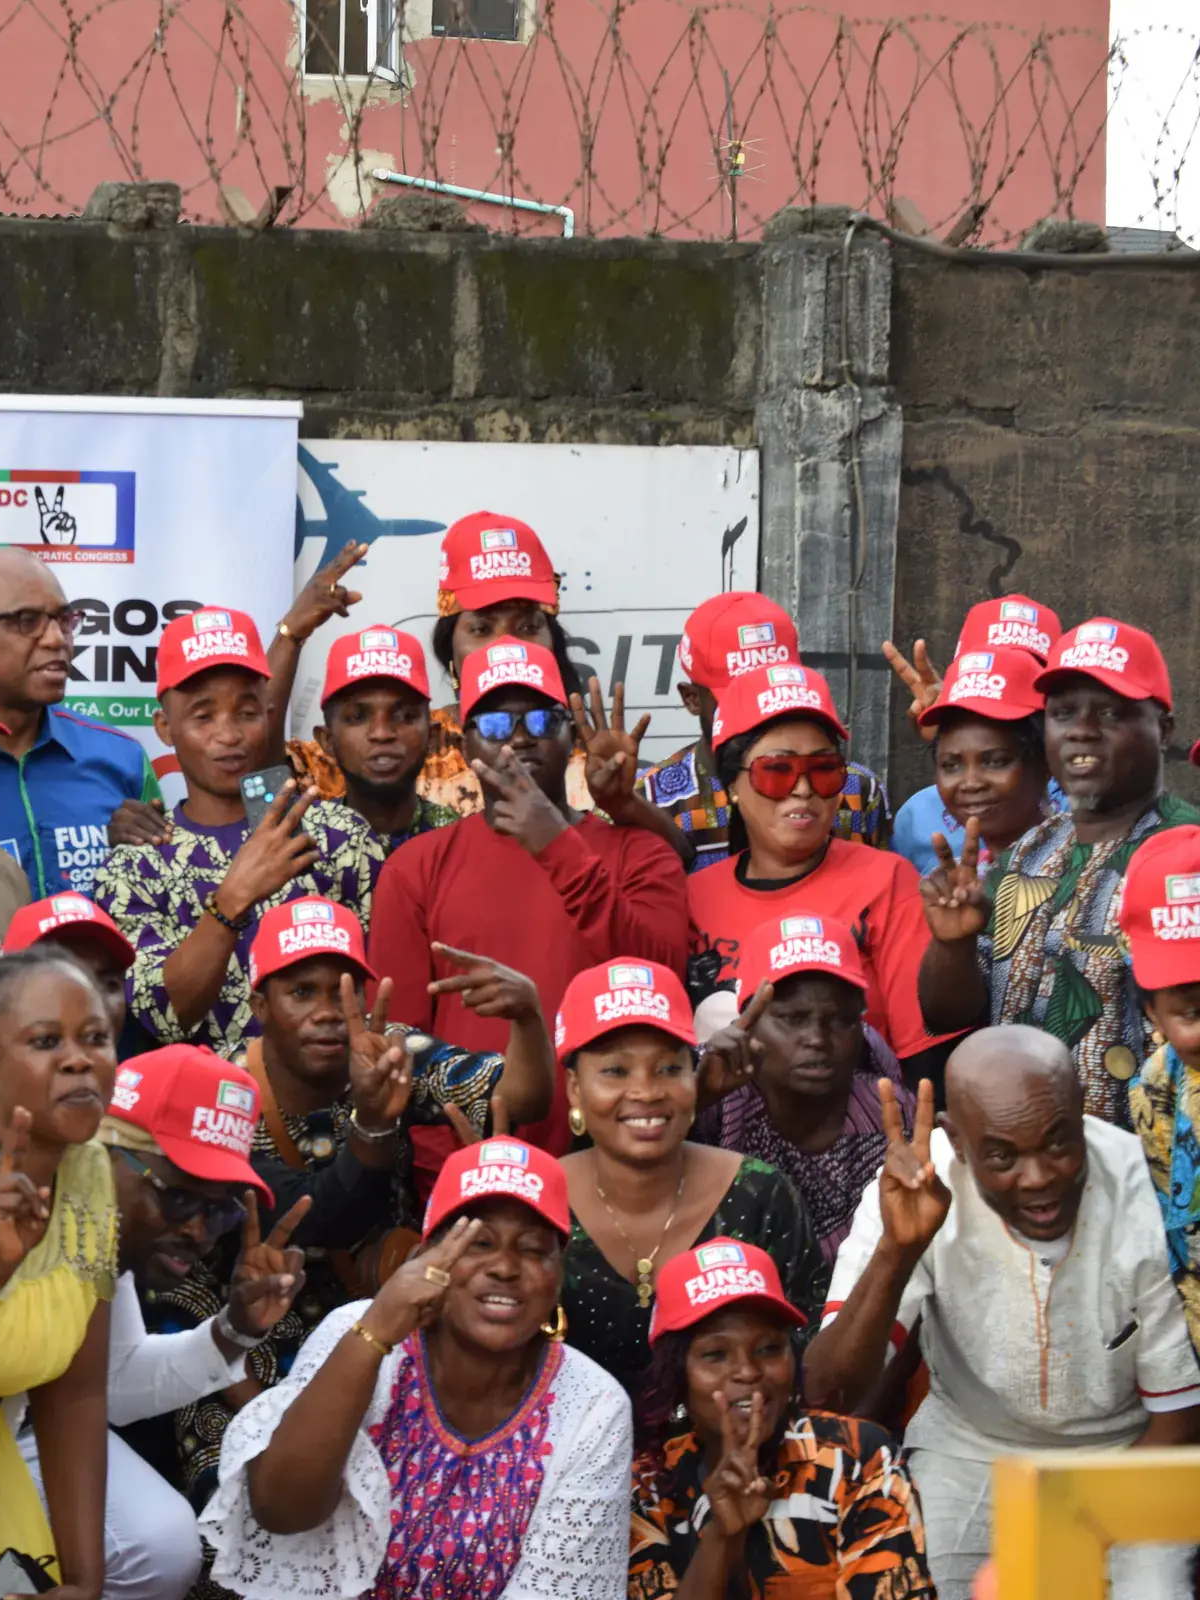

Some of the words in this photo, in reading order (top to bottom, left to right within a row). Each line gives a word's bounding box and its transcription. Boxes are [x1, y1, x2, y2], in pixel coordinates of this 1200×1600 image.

[75, 551, 128, 562] CONGRESS
[470, 551, 531, 574] FUNSO
[182, 631, 248, 655] FUNSO
[988, 622, 1051, 647] FUNSO
[347, 651, 412, 671] FUNSO
[726, 645, 789, 669] FUNSO
[477, 661, 543, 688] FUNSO
[757, 685, 820, 709] FUNSO
[108, 703, 140, 717] Our
[279, 924, 351, 948] FUNSO
[770, 938, 840, 962] FUNSO
[594, 988, 670, 1014] FUNSO
[460, 1166, 543, 1191] FUNSO
[685, 1267, 766, 1298] FUNSO
